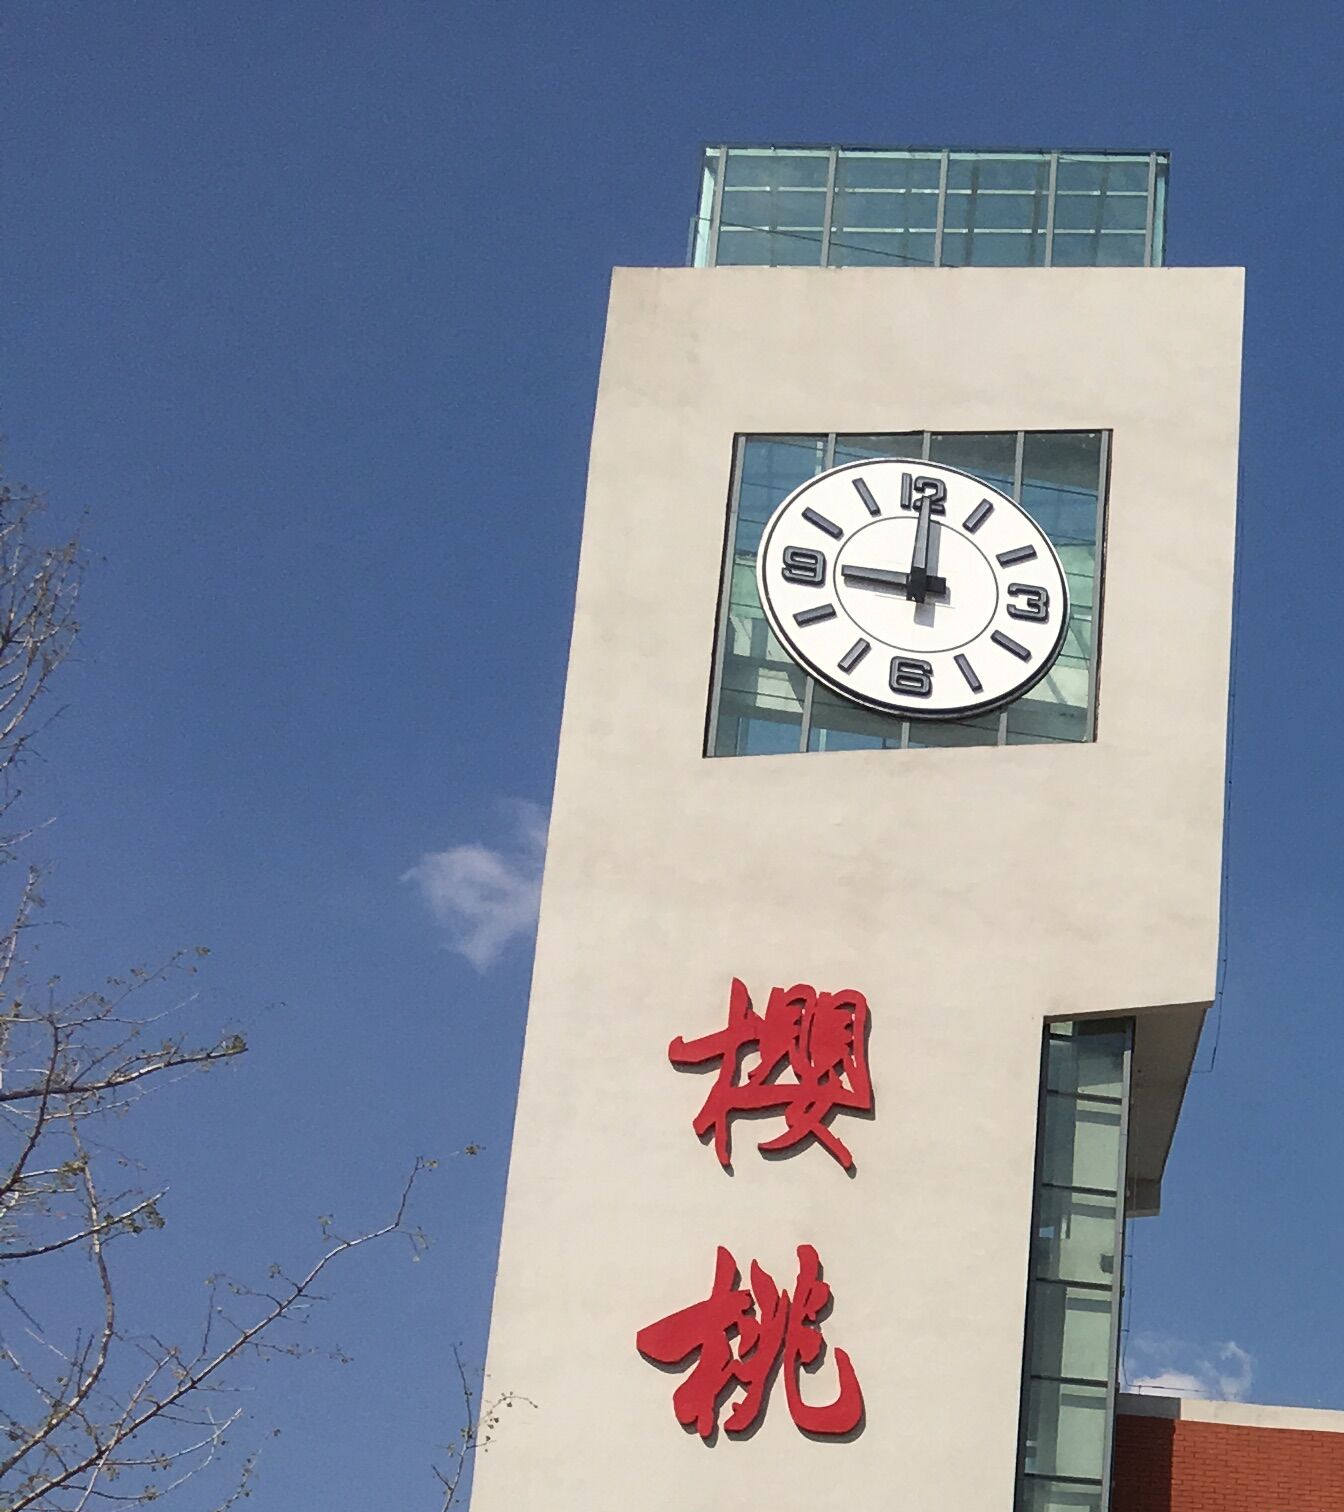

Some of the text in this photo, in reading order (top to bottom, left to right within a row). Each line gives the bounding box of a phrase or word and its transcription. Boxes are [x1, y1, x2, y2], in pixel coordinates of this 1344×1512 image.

[900, 473, 947, 515] 12
[781, 545, 826, 586] 9
[1007, 582, 1050, 623] 3
[889, 656, 933, 697] 6
